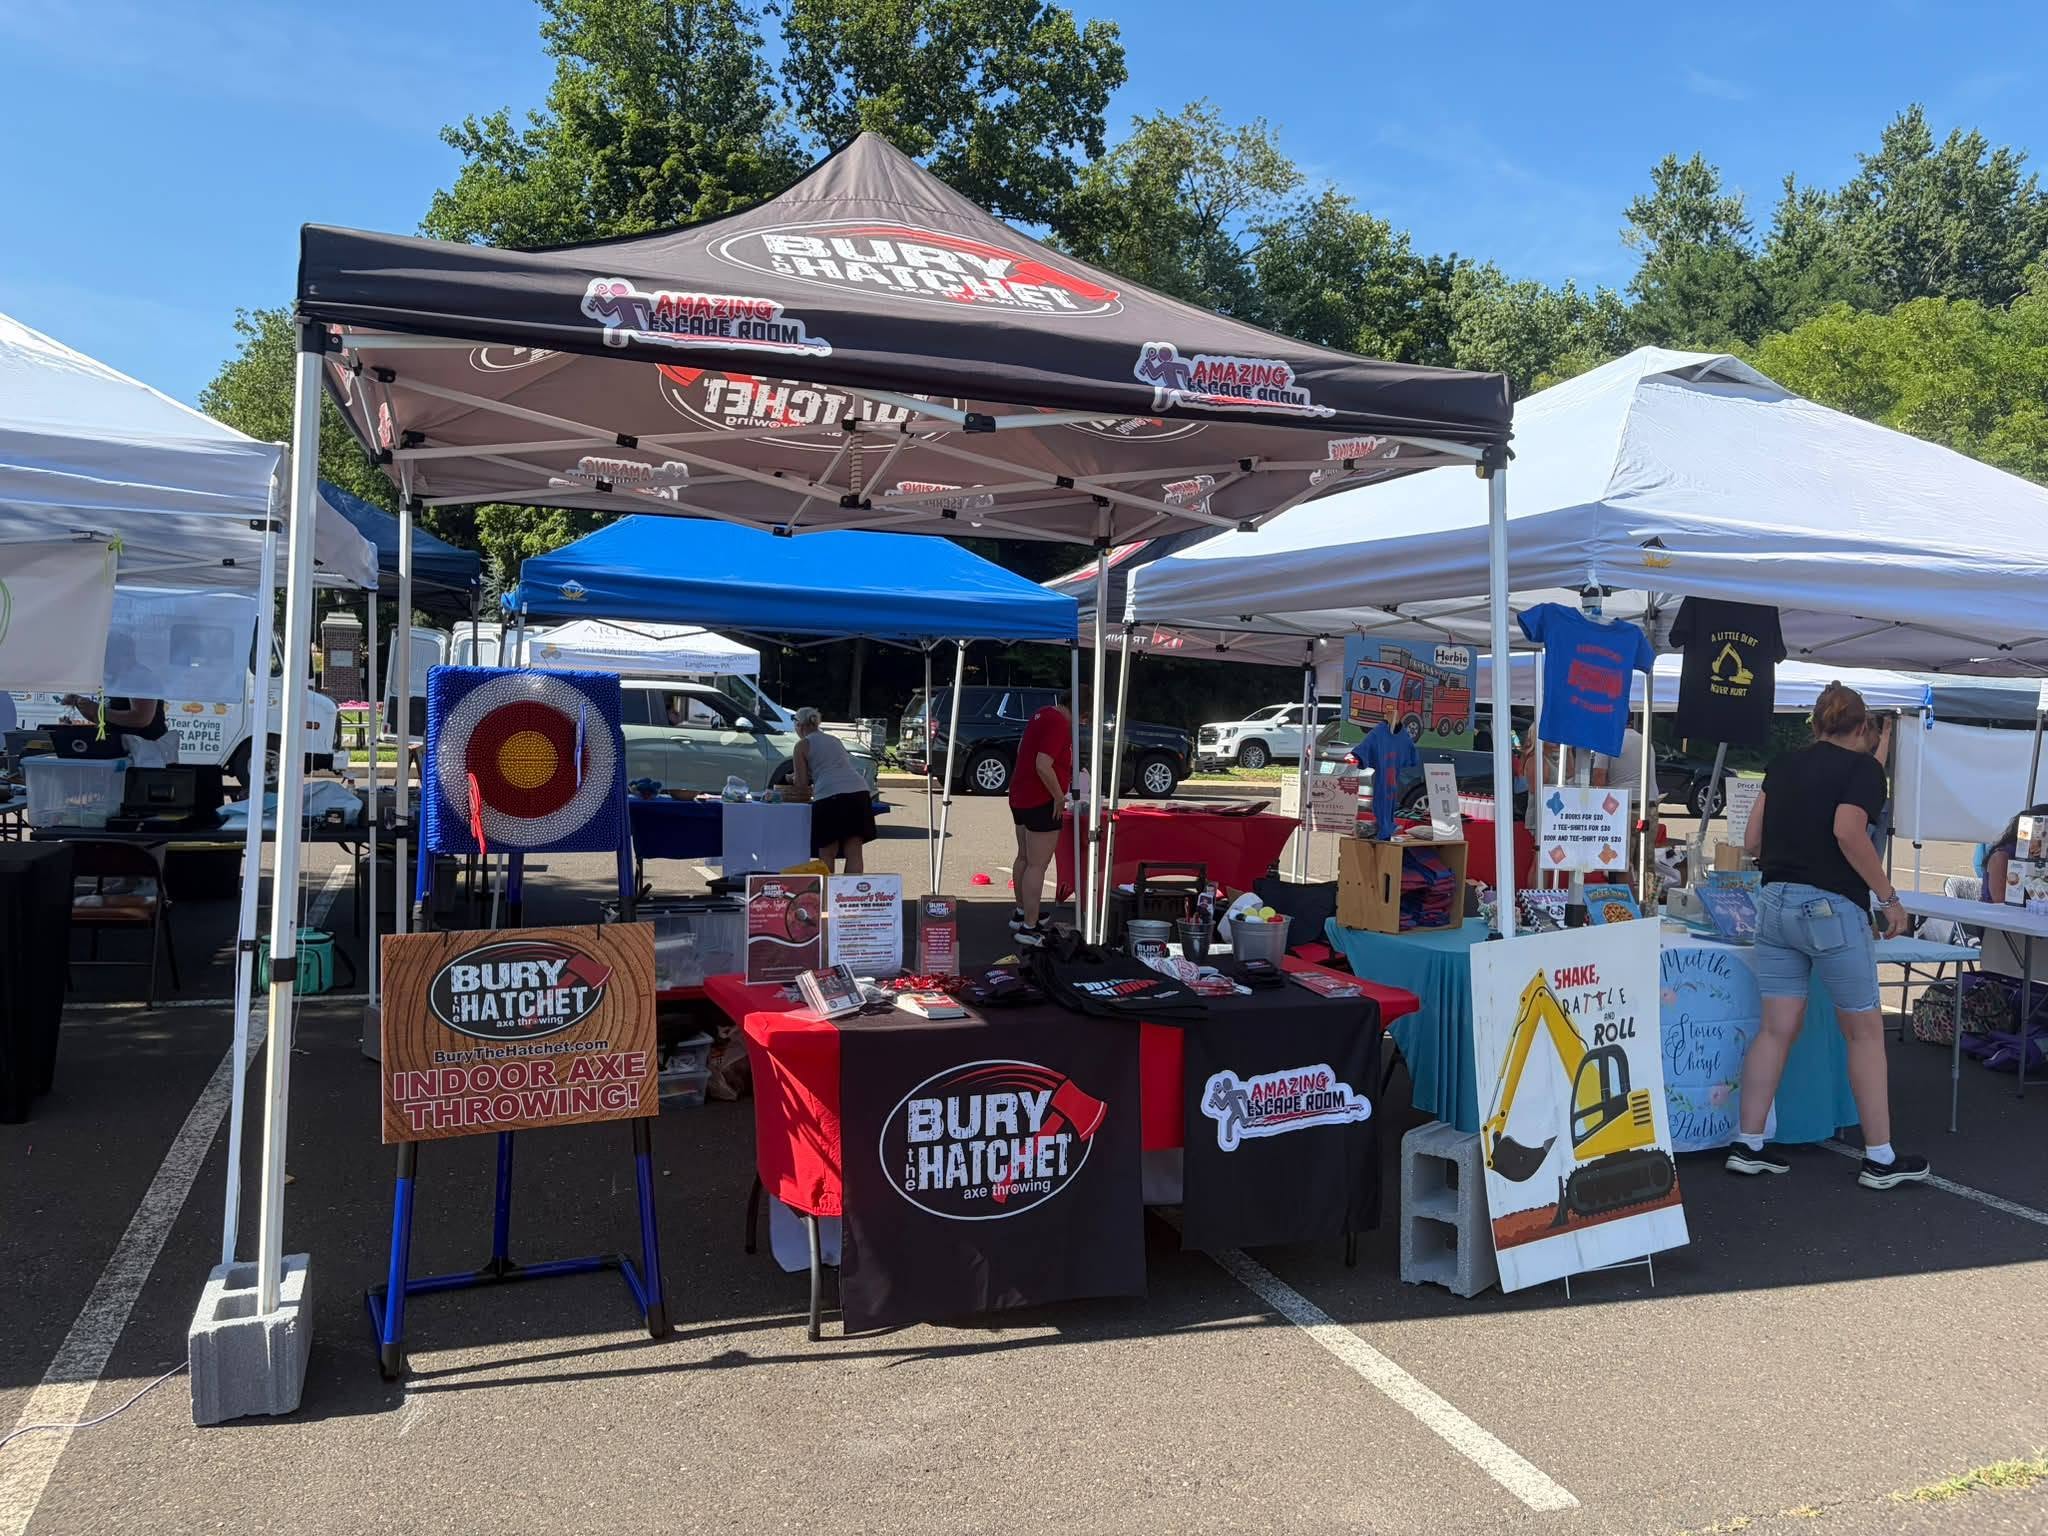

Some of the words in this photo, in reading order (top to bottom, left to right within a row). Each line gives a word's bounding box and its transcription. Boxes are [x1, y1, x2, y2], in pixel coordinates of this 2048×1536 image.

[762, 234, 1017, 279] BURY
[795, 255, 1077, 310] HATCHET
[656, 294, 776, 321] AMAZING
[888, 285, 935, 295] axe
[942, 290, 1055, 312] throwing
[649, 311, 731, 338] ESCAPE
[738, 321, 801, 344] ROOM
[1193, 360, 1290, 389] AMAZING
[1717, 631, 1740, 641] LITTLE
[1741, 633, 1759, 648] DIRT
[1436, 649, 1468, 663] Herbie
[171, 718, 190, 727] Tear
[193, 720, 221, 731] Crying
[188, 731, 221, 741] APPLE
[181, 742, 196, 751] an
[200, 742, 220, 751] Ice
[1137, 943, 1160, 952] BURY
[450, 959, 567, 993] BURY
[1554, 964, 1600, 990] SHAKE,
[1660, 948, 1707, 982] Meet
[1707, 951, 1732, 980] the
[452, 996, 461, 1023] the
[461, 986, 588, 1023] HATCHET
[1562, 987, 1626, 1016] RATTLE
[1604, 1011, 1616, 1021] AND
[496, 1018, 515, 1028] axe
[517, 1014, 564, 1027] throwing
[1594, 1016, 1636, 1046] ROLL
[1669, 1013, 1725, 1043] Stories
[434, 1039, 609, 1064] BuryTheHatchet.com
[1665, 1039, 1721, 1079] Cheryl
[394, 1060, 556, 1100] INDOOR
[567, 1051, 646, 1084] AXE
[1251, 1071, 1331, 1102] AMAZING
[404, 1082, 639, 1130] THROWING!
[907, 1090, 1053, 1143] BURY
[1247, 1095, 1303, 1117] ESCAPE
[1306, 1090, 1345, 1111] ROOM
[1669, 1110, 1733, 1139] Author
[905, 1148, 915, 1191] the
[917, 1133, 1072, 1190] HATCHET
[963, 1184, 988, 1200] axe
[992, 1179, 1051, 1198] throwing
